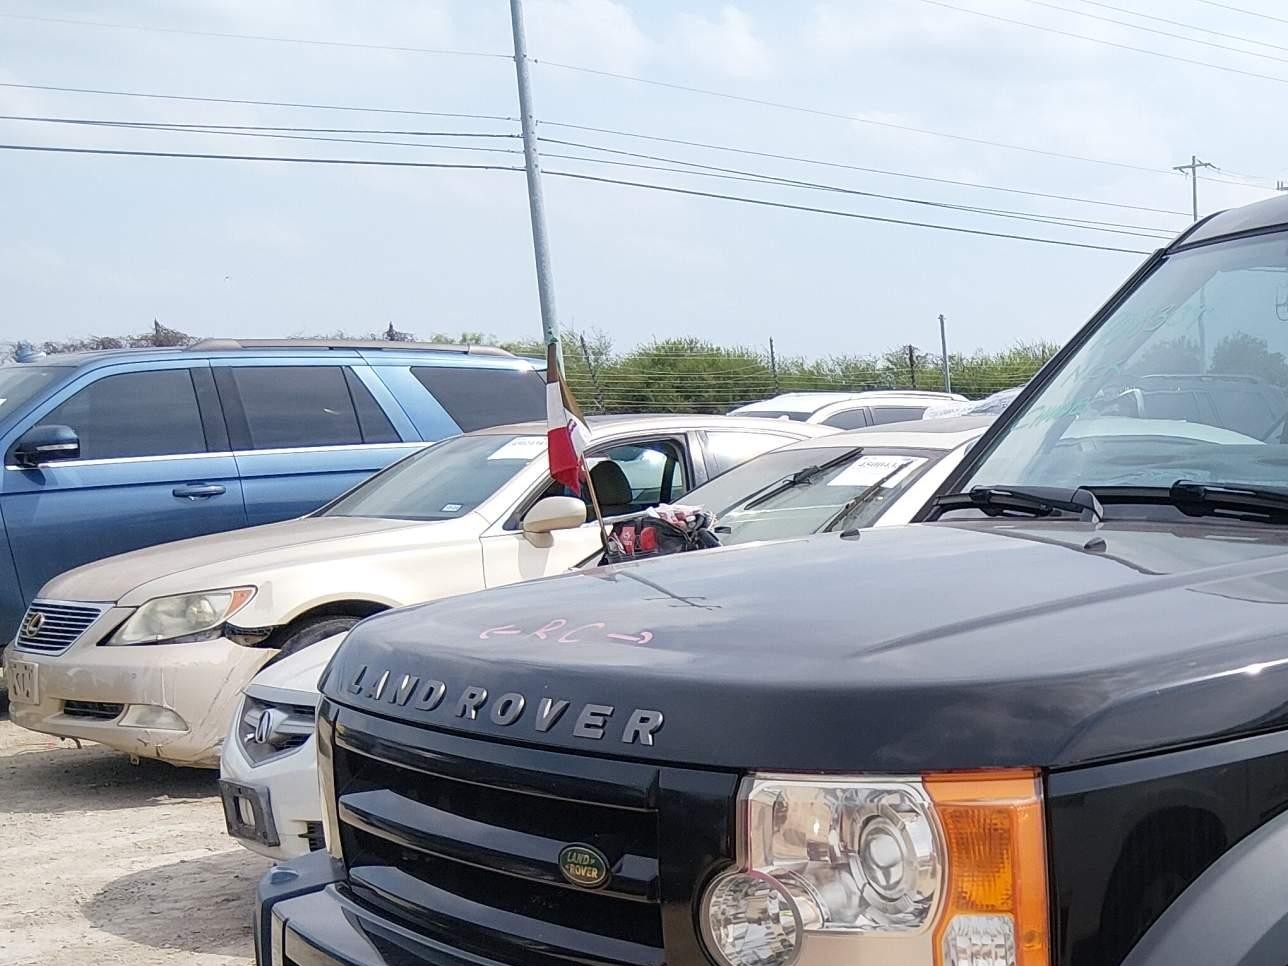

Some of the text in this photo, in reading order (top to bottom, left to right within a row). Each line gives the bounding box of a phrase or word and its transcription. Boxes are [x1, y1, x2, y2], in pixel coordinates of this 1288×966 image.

[347, 664, 665, 746] LAND ROVER
[567, 851, 590, 864] LAND
[569, 863, 599, 879] ROVER
